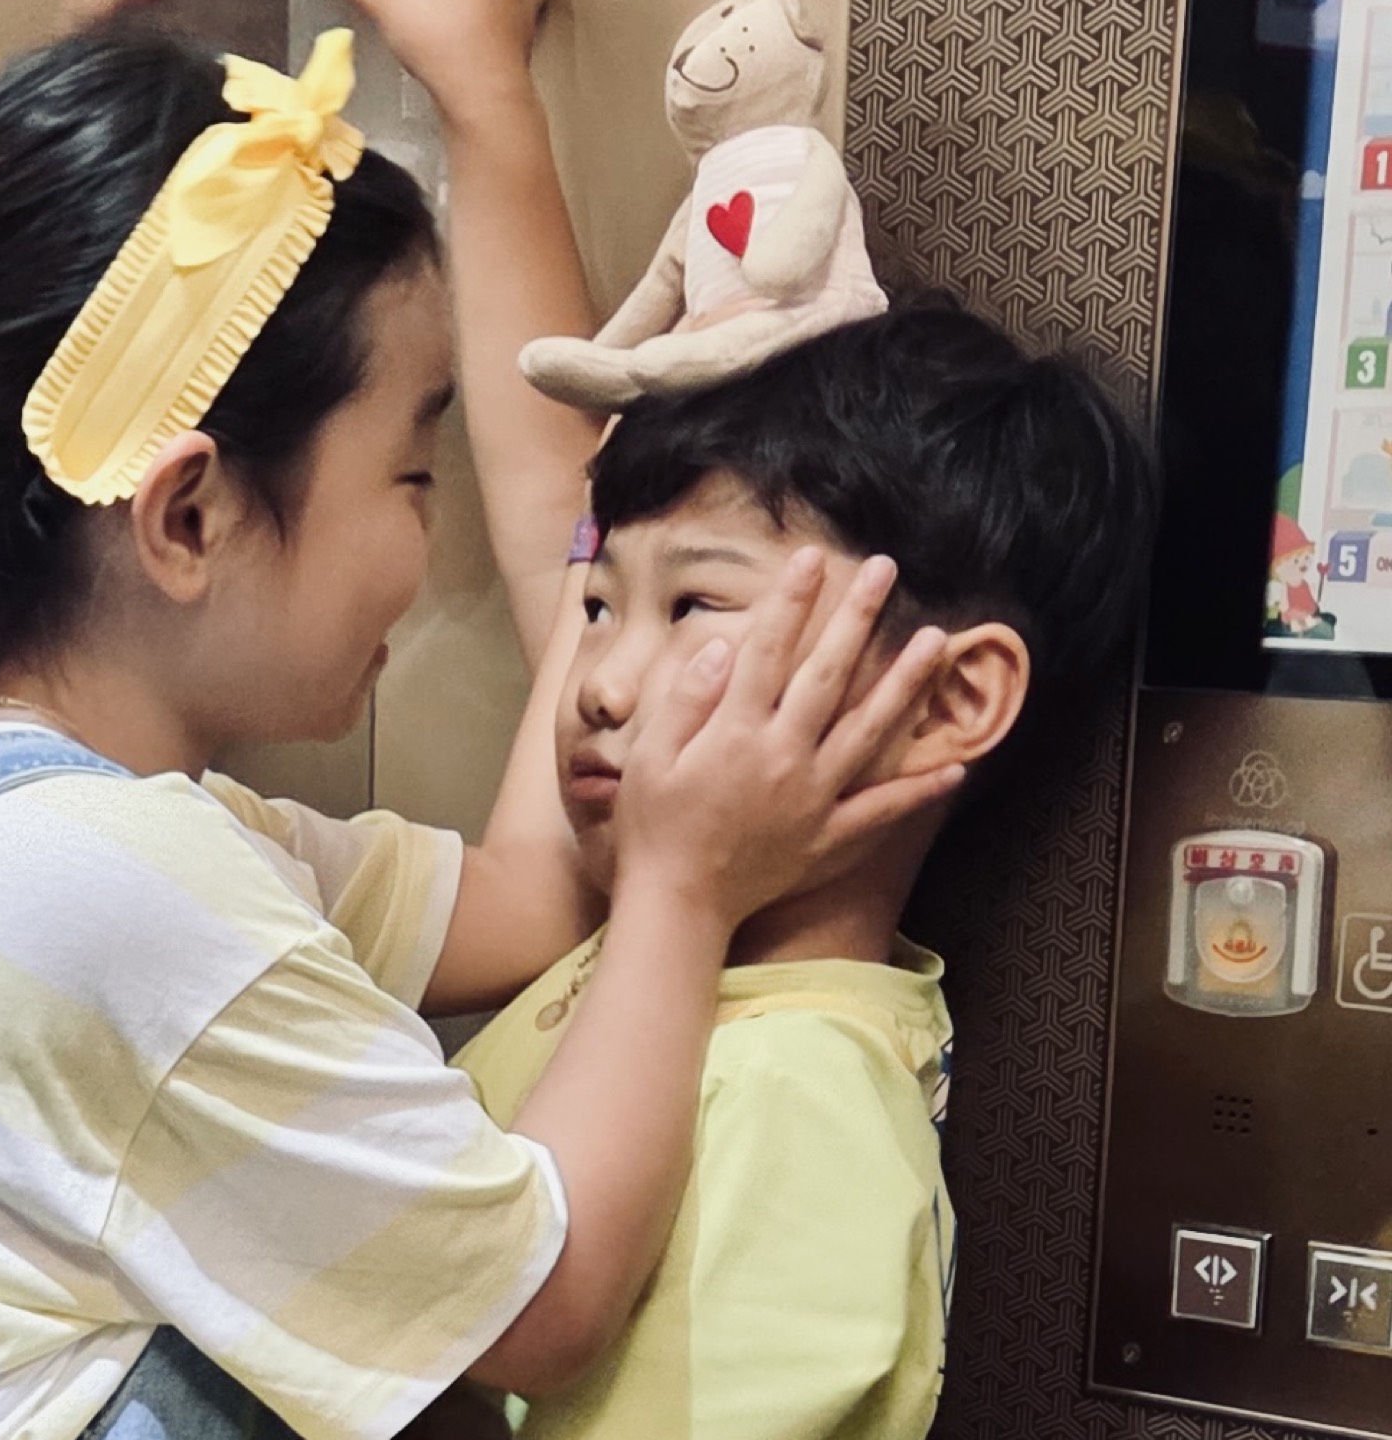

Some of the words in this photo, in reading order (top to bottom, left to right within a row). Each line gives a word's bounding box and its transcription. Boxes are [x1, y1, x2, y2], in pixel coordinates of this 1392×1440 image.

[1376, 150, 1388, 185] 1
[1357, 350, 1377, 384] 3
[1339, 545, 1358, 577] 5
